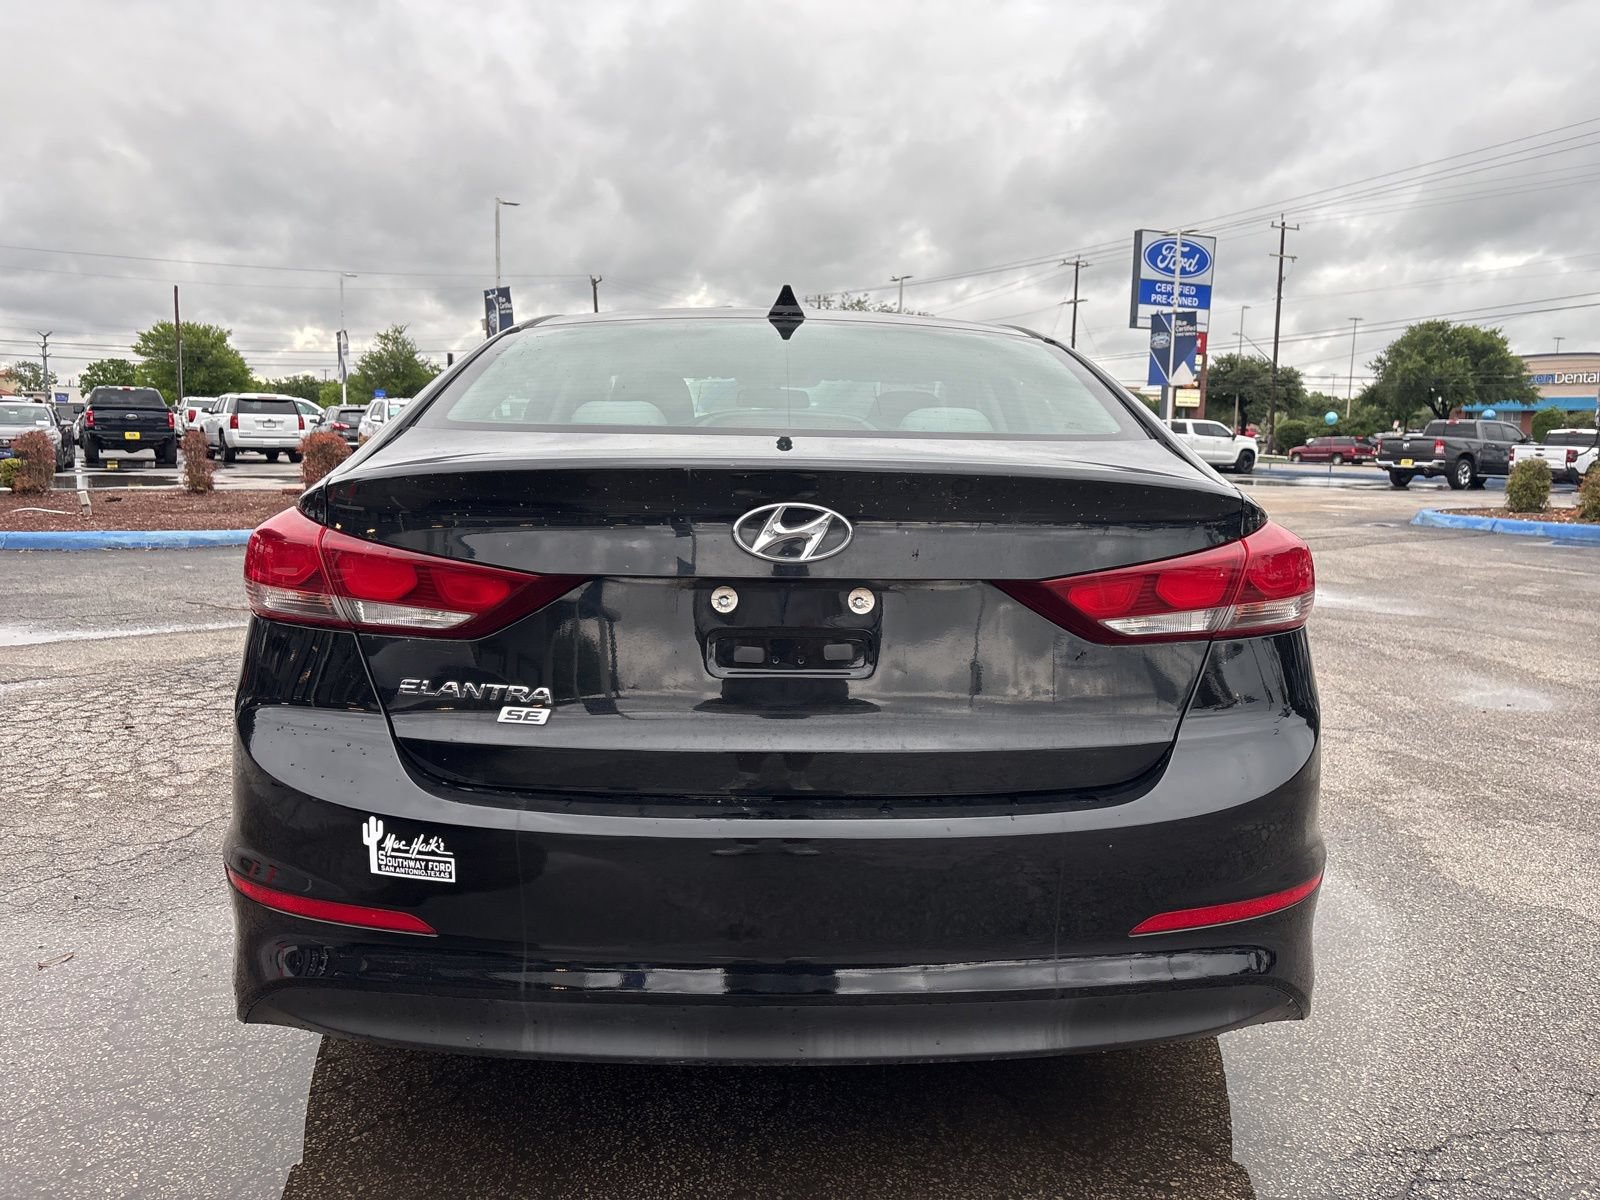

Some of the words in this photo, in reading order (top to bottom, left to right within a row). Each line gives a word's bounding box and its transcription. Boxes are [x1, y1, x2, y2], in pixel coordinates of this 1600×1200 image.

[1157, 243, 1200, 272] Ford
[1155, 283, 1196, 295] CERTFIED
[398, 678, 553, 705] ELANTRA
[505, 709, 542, 722] SE
[381, 833, 410, 856] Mac
[409, 834, 453, 859] Haik's
[378, 850, 426, 870] SOUTHWAY
[428, 862, 452, 872] FORD
